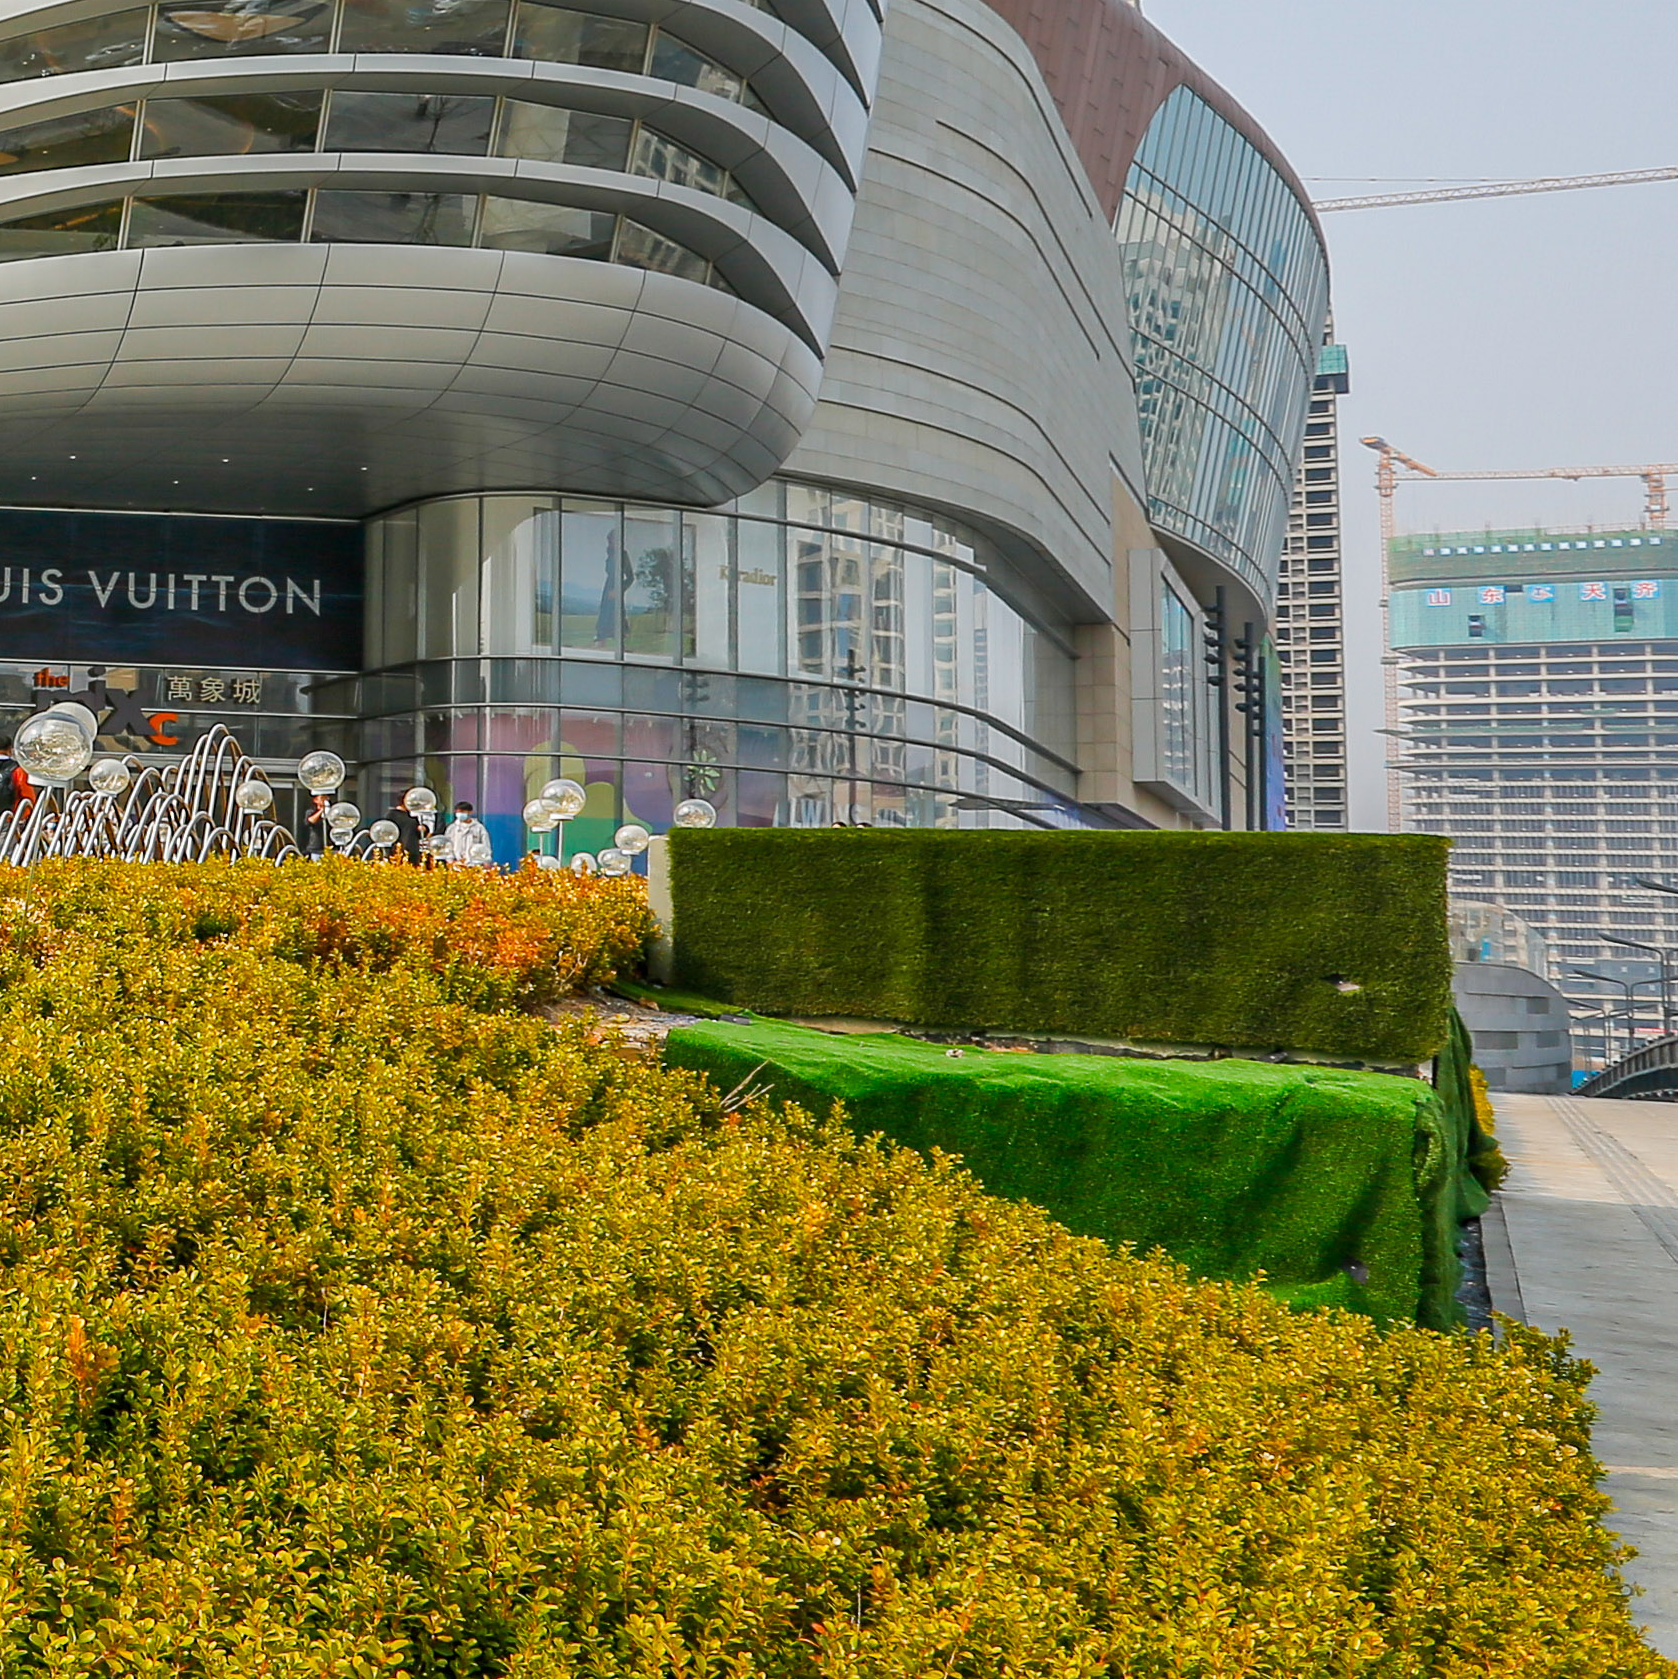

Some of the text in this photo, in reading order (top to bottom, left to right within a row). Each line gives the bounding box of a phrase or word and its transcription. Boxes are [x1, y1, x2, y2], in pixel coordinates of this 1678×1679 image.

[87, 569, 321, 617] VUITTON
[34, 667, 69, 688] the
[166, 675, 261, 704] 萬象城
